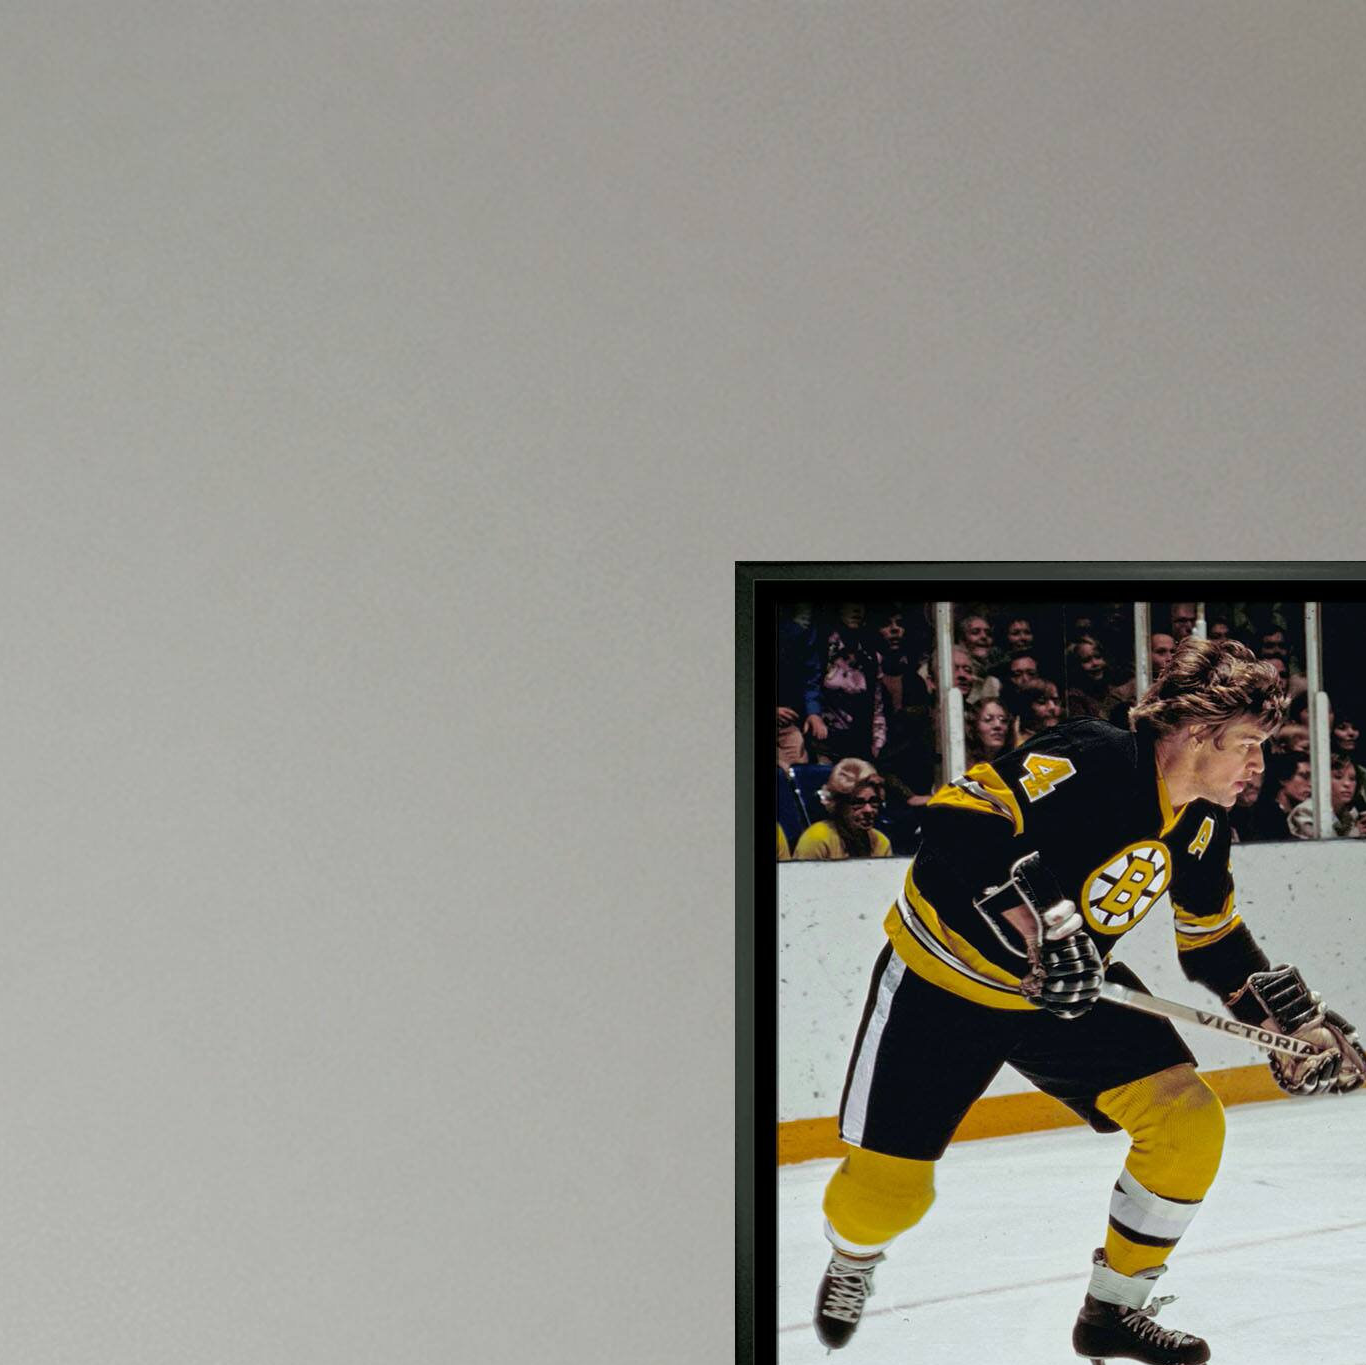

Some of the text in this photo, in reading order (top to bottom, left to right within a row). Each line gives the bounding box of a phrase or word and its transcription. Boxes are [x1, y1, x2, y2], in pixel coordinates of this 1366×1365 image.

[1019, 753, 1077, 803] 4
[1187, 816, 1215, 861] A
[1098, 856, 1156, 917] B
